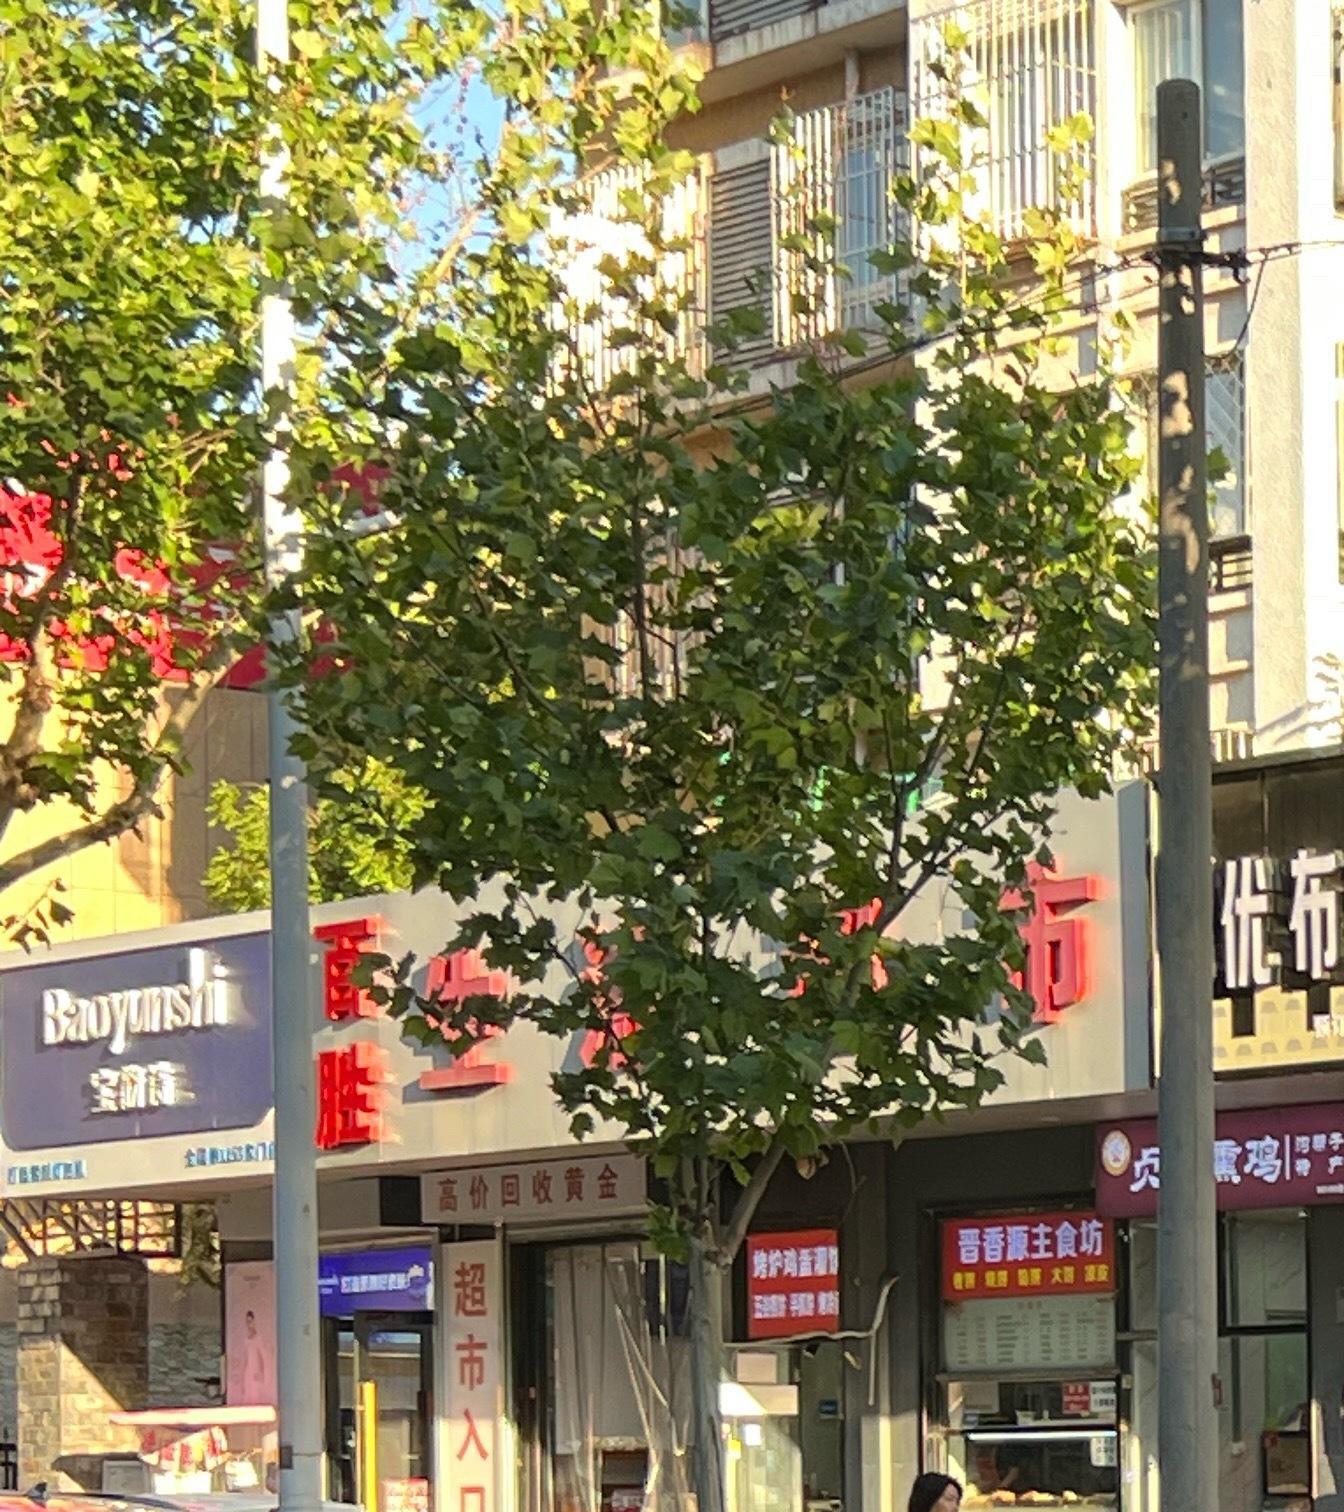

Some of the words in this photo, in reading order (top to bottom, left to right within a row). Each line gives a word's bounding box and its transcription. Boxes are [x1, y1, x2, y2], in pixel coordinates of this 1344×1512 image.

[43, 948, 229, 1055] Baoyunshi
[437, 1163, 618, 1213] 高价回收黄金
